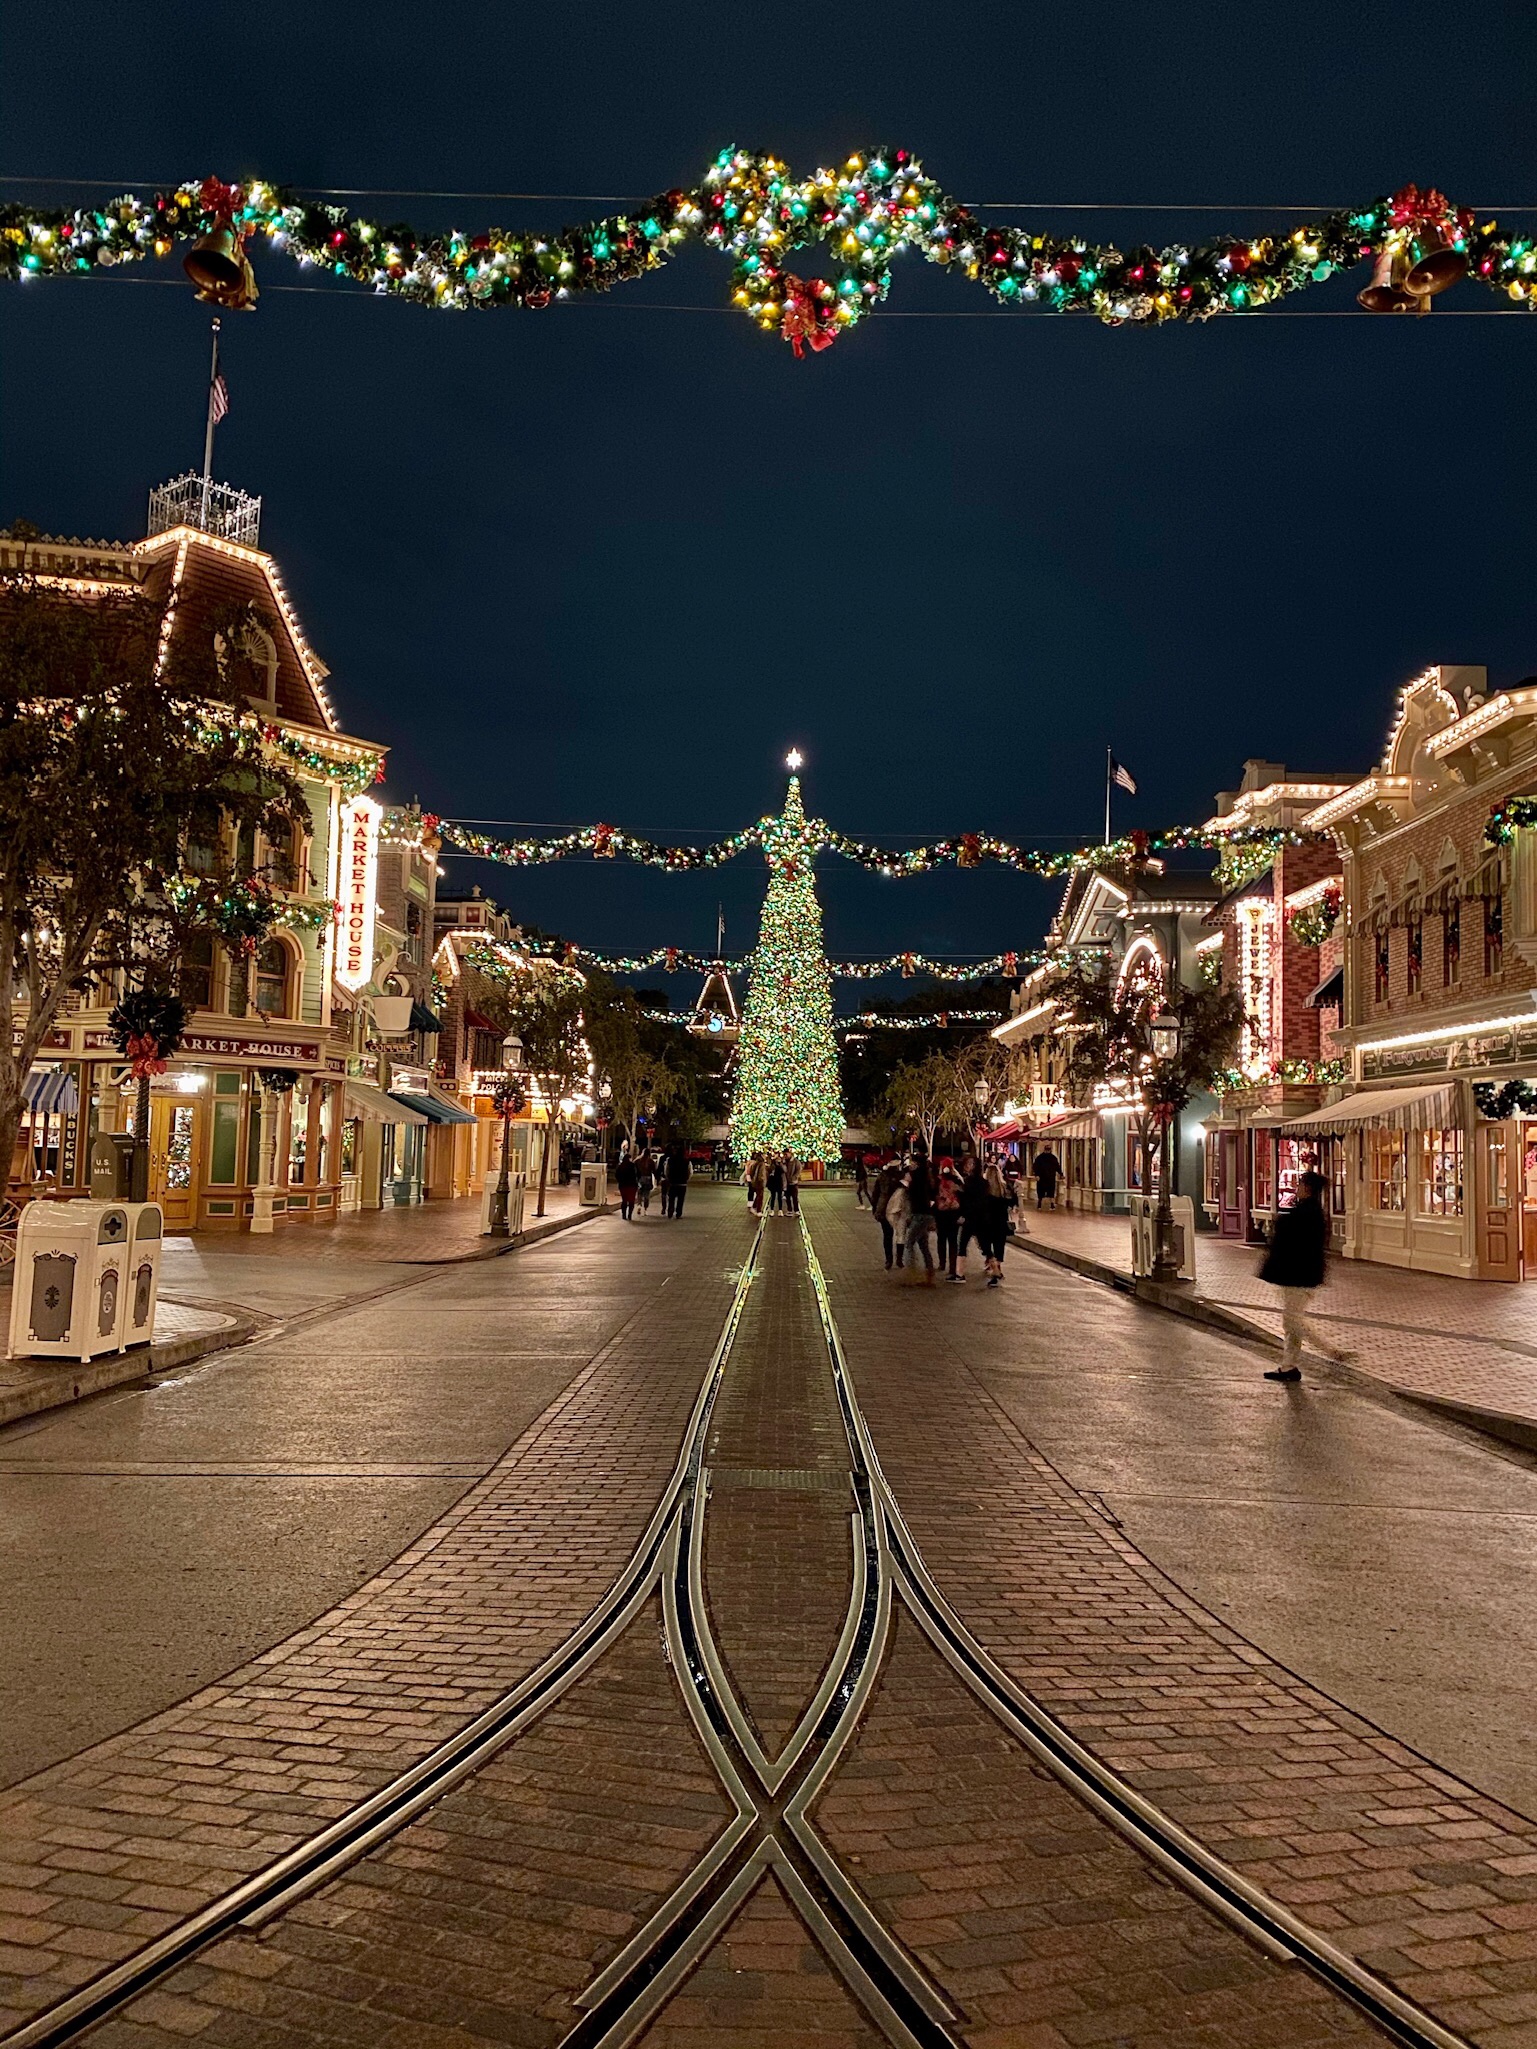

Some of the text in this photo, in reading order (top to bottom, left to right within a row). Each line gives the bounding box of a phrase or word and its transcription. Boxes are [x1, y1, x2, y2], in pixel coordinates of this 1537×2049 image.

[347, 813, 370, 971] MARKET HOUSE
[178, 1037, 303, 1058] ARKET HOUSE
